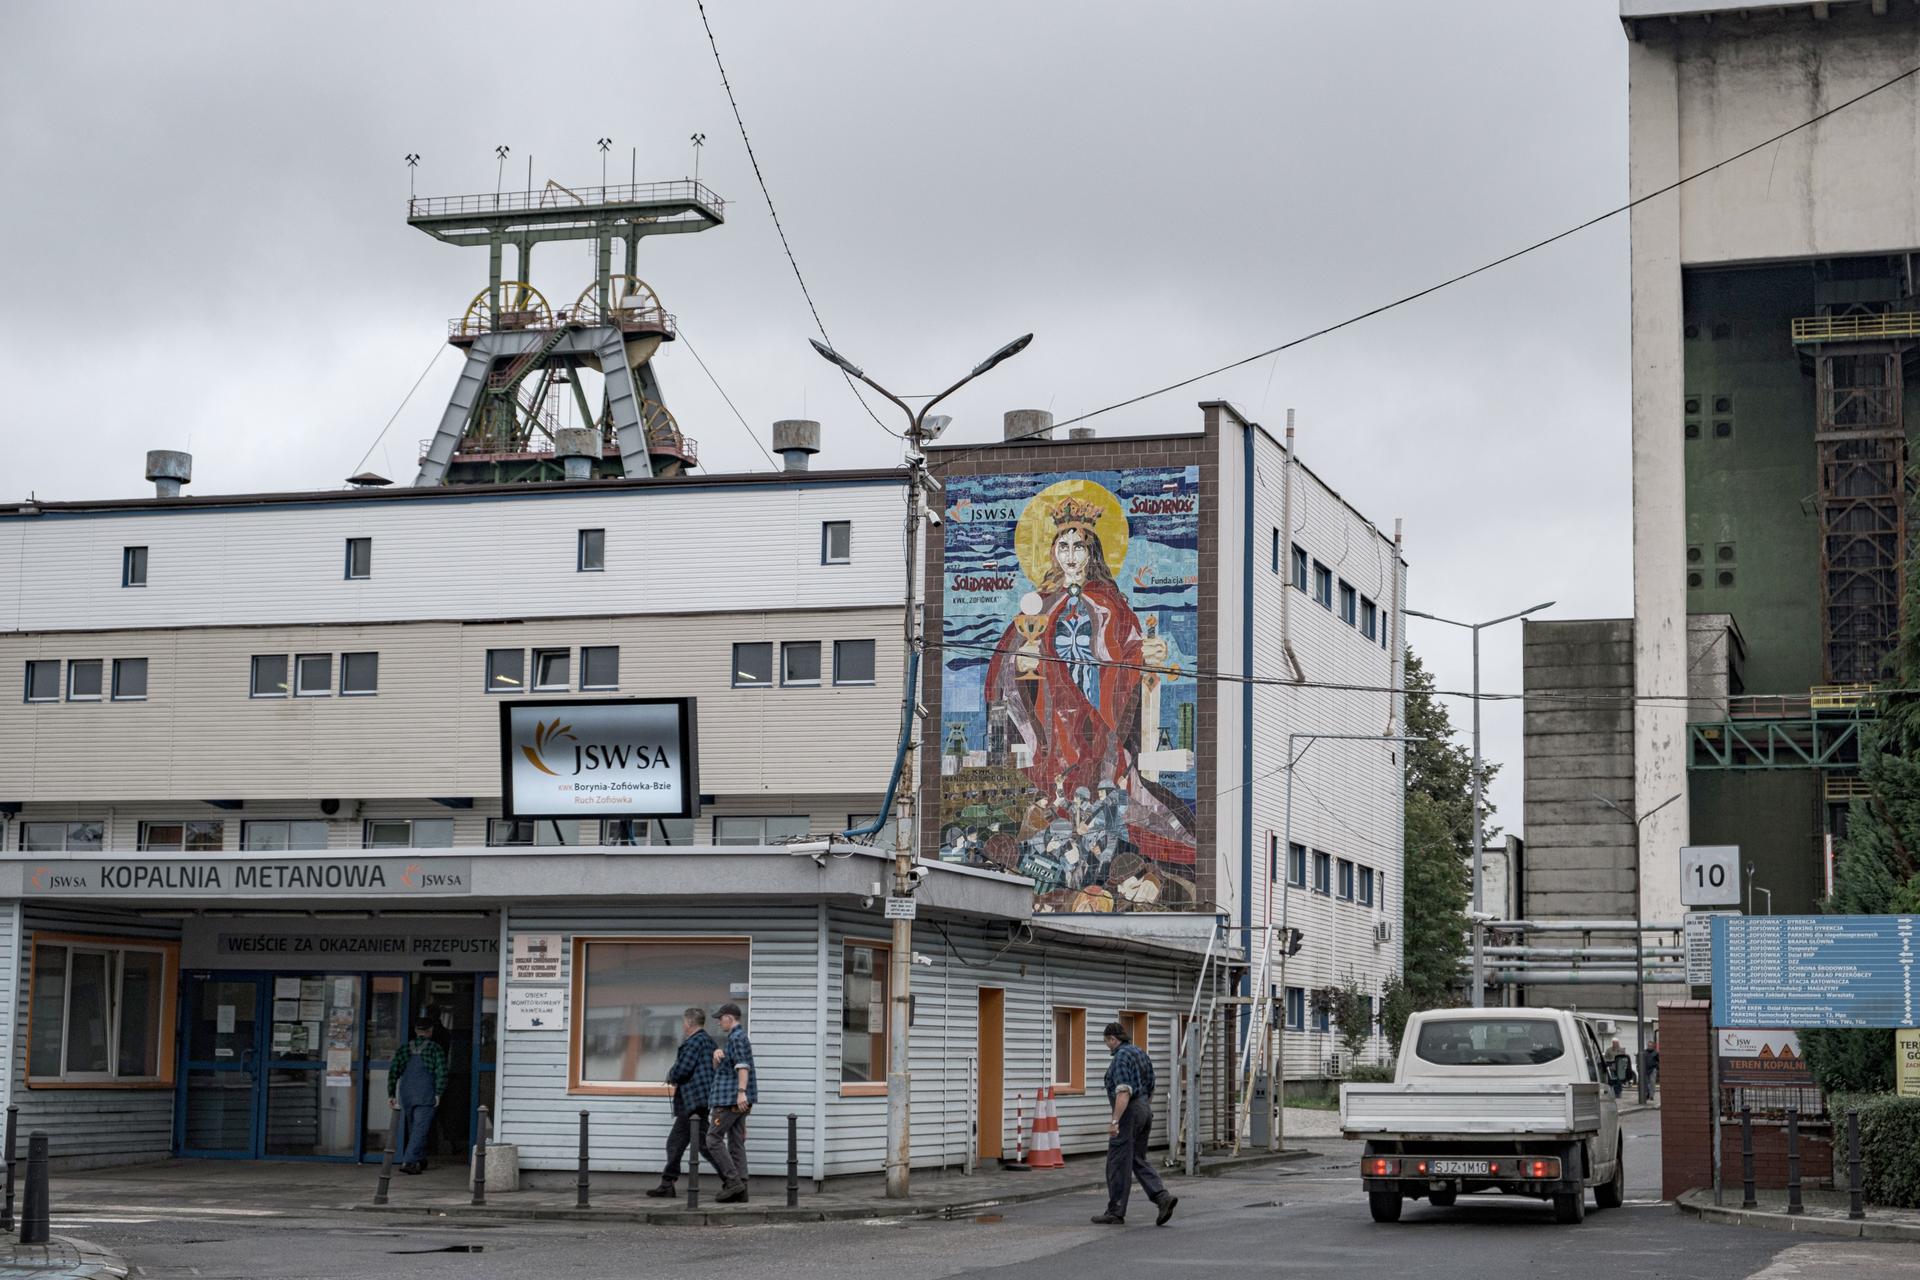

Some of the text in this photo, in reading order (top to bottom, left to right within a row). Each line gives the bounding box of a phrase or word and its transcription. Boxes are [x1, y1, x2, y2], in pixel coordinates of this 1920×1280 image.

[1150, 576, 1184, 586] Fundacja
[572, 744, 670, 776] JSW SA
[574, 781, 672, 793] Borynia-Zofiówka-Bzie
[574, 795, 632, 804] Ruch Zofiówka
[49, 865, 462, 889] JSW SA KOPALNIA METANOWA JSW SA
[1024, 862, 1054, 880] MILICJA
[1695, 863, 1725, 888] 10
[228, 934, 288, 952] WEJŚCIE
[294, 938, 313, 951] ZA
[319, 938, 405, 953] OKAZANIEM
[1900, 1041, 1920, 1049] TER
[1729, 1060, 1807, 1071] TEREN KOPALNI
[1435, 1162, 1488, 1173] SJZ 1M10
